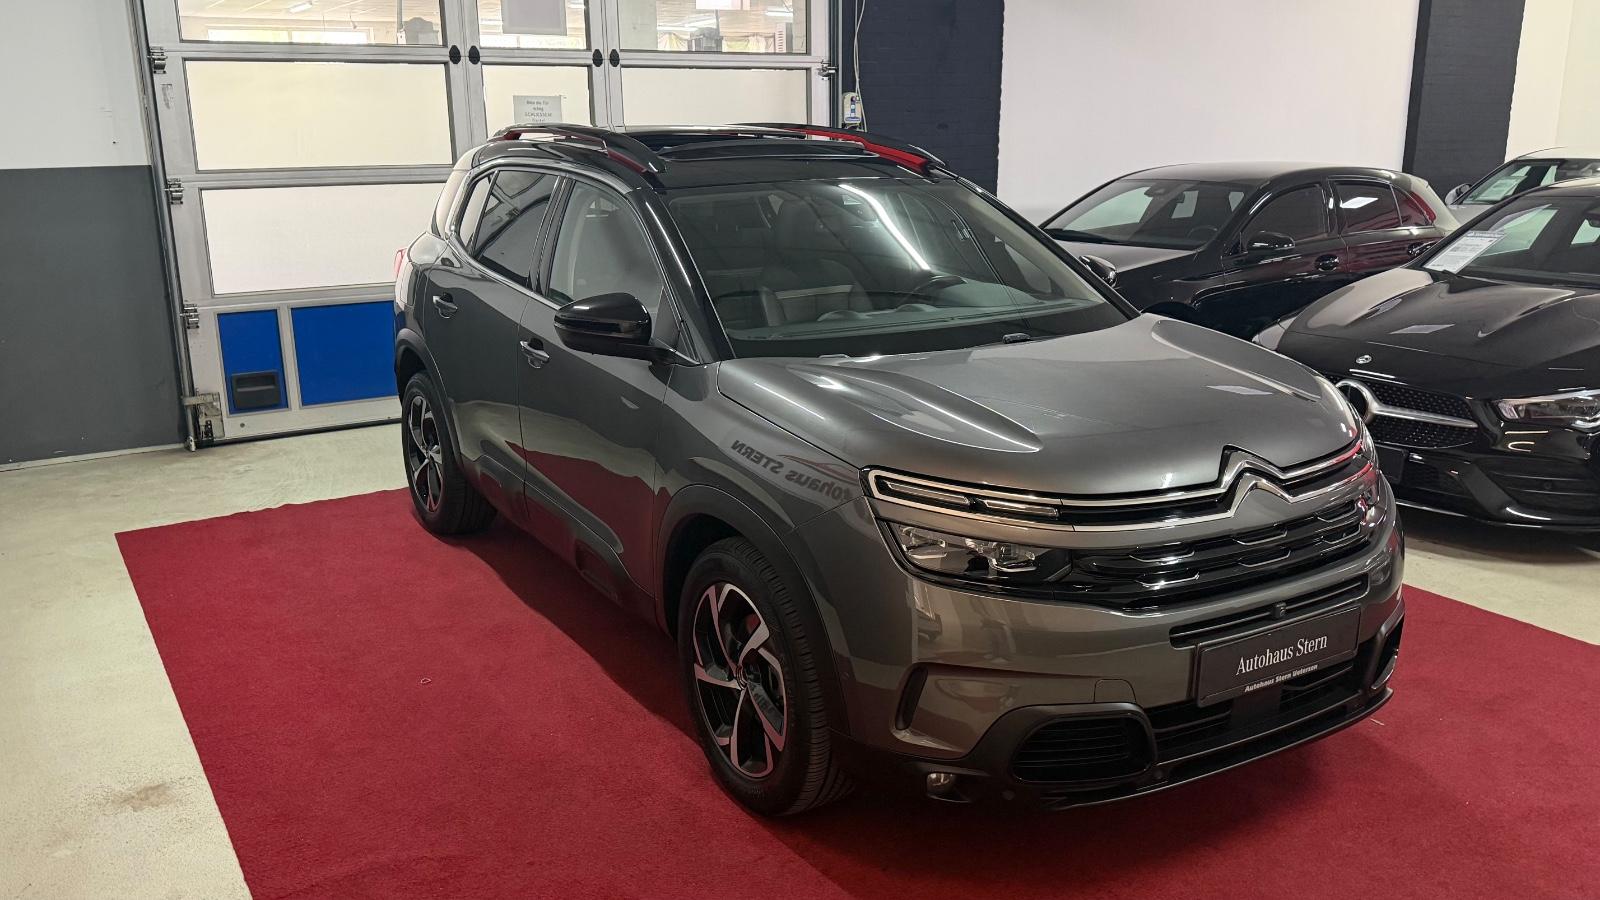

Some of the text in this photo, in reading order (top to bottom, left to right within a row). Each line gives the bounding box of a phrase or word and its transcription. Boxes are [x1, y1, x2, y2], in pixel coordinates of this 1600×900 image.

[1235, 635, 1328, 676] Autohaus Stern
[1244, 678, 1275, 693] Autohaus
[1275, 672, 1292, 683] Stern
